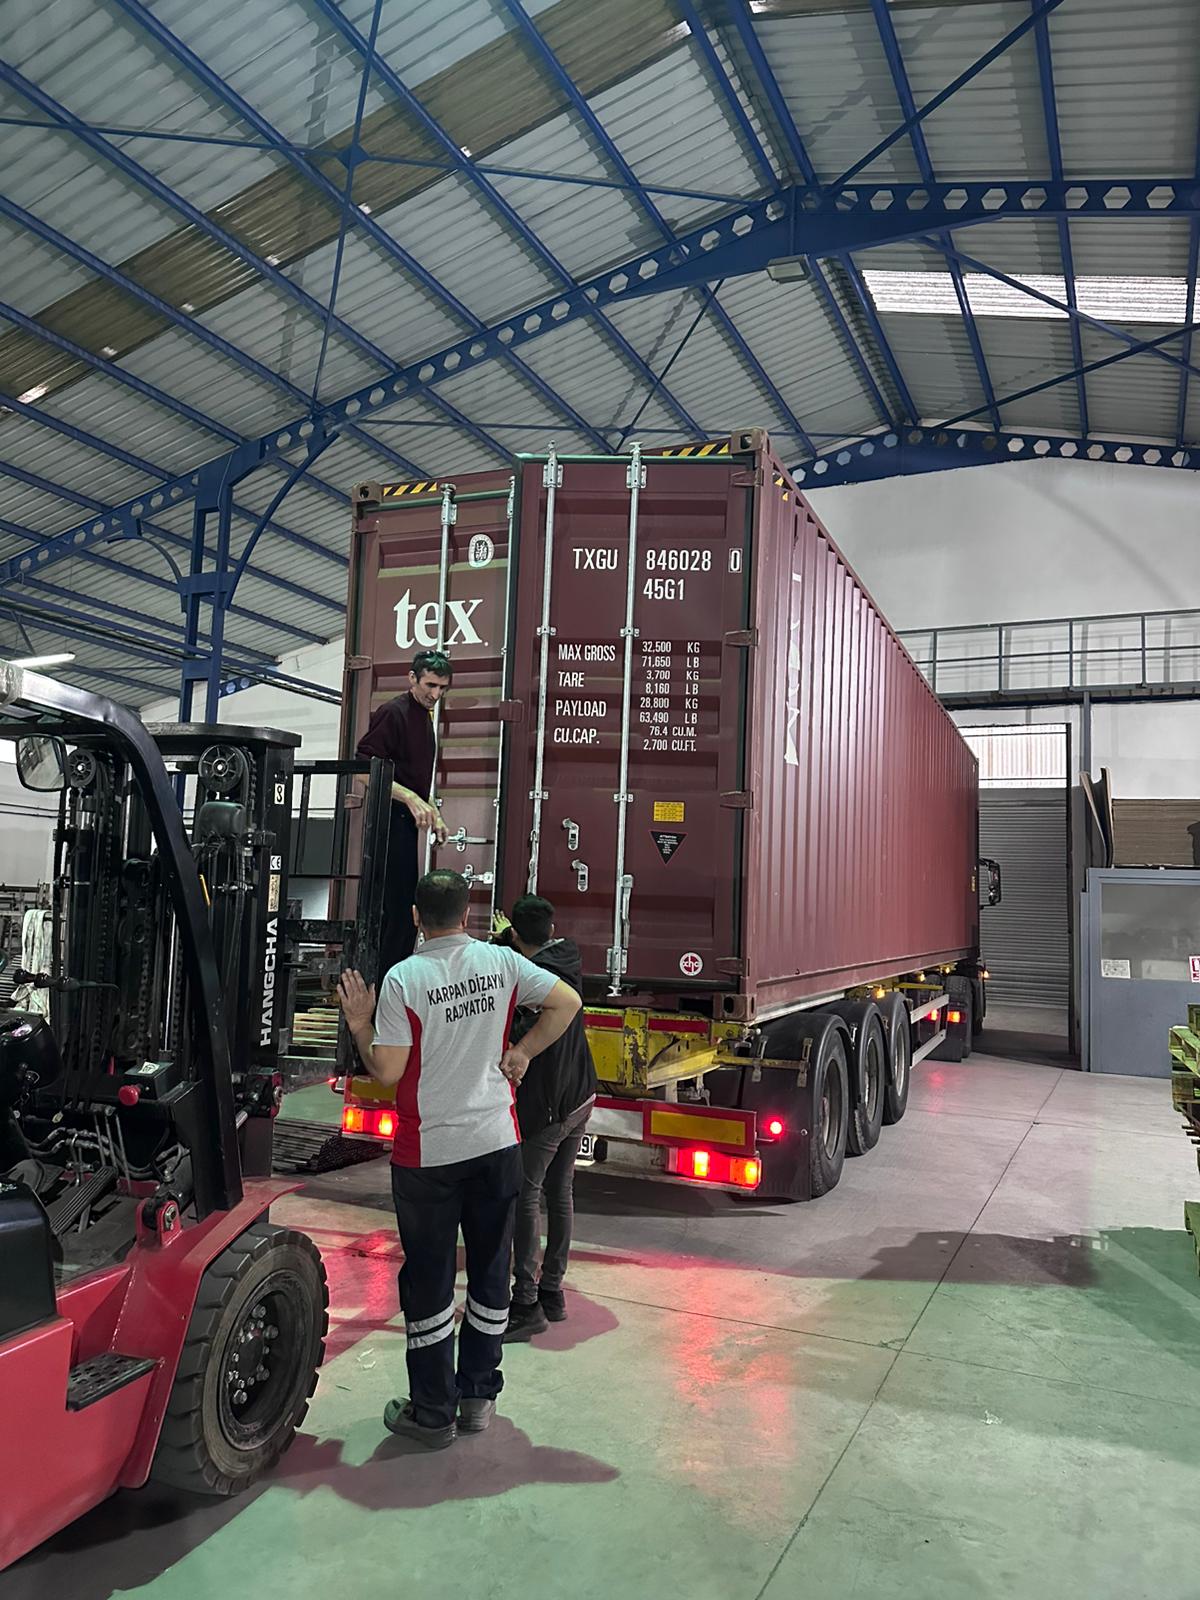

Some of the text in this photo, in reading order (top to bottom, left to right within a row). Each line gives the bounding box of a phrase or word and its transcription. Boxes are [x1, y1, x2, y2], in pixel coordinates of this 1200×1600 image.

[573, 548, 741, 572] TXGU 846028 0
[643, 578, 684, 600] 45G1
[558, 641, 700, 661] MAX GROSS 32,500 KG
[641, 656, 671, 668] 71,650
[558, 670, 699, 688] TARE 3,700 KG
[645, 683, 670, 694] 8,160
[555, 697, 698, 717] PAYLOAD 28,800 KG
[639, 712, 669, 723] 63,490
[553, 728, 600, 744] CU.CAP.
[650, 726, 668, 737] 76.4
[643, 739, 668, 751] 2,700
[260, 917, 278, 1047] HANGCHA
[427, 980, 468, 1006] KARPAN
[445, 993, 496, 1023] RADYATÖR
